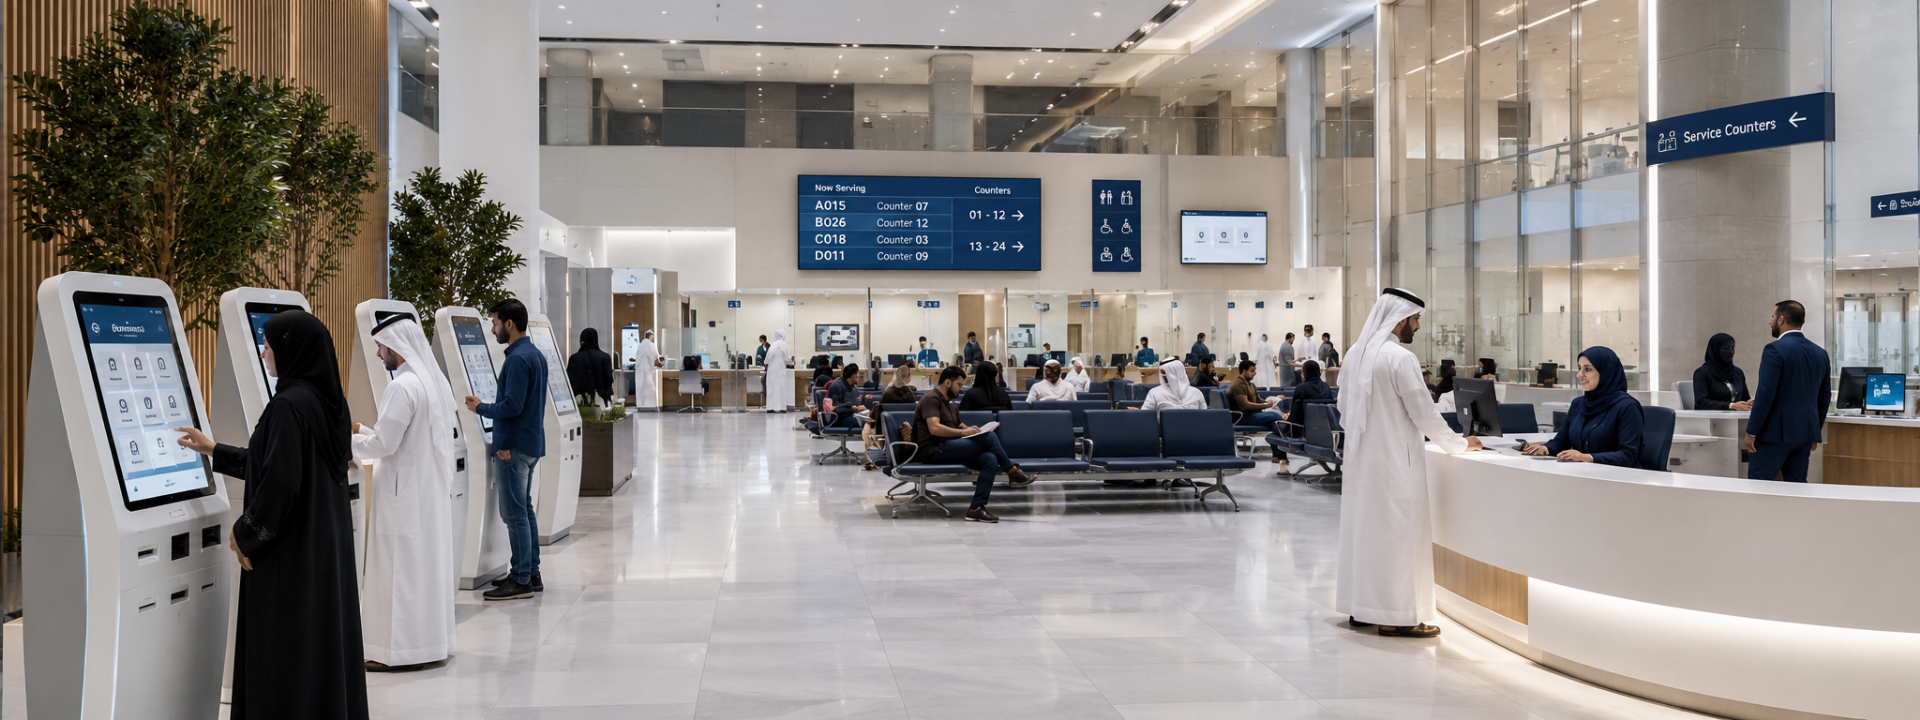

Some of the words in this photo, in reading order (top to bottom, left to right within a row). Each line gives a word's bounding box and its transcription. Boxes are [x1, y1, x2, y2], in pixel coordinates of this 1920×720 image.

[1683, 127, 1722, 144] Service
[1725, 119, 1777, 137] Counters
[815, 184, 833, 193] Now
[835, 184, 866, 194] Serving
[974, 186, 1011, 195] Counters
[814, 200, 846, 211] A015
[876, 201, 913, 211] Counter
[915, 201, 929, 211] 07
[969, 210, 982, 220] 01
[993, 210, 1006, 220] 12
[815, 216, 847, 228] B026
[876, 218, 913, 228] Counter
[916, 218, 929, 228] 12
[814, 233, 847, 245] C018
[876, 234, 913, 244] Counter
[915, 235, 929, 245] 03
[969, 241, 983, 251] 13
[992, 241, 1006, 251] 24
[815, 250, 845, 261] D011
[876, 251, 913, 261] Counter
[915, 251, 929, 261] 09
